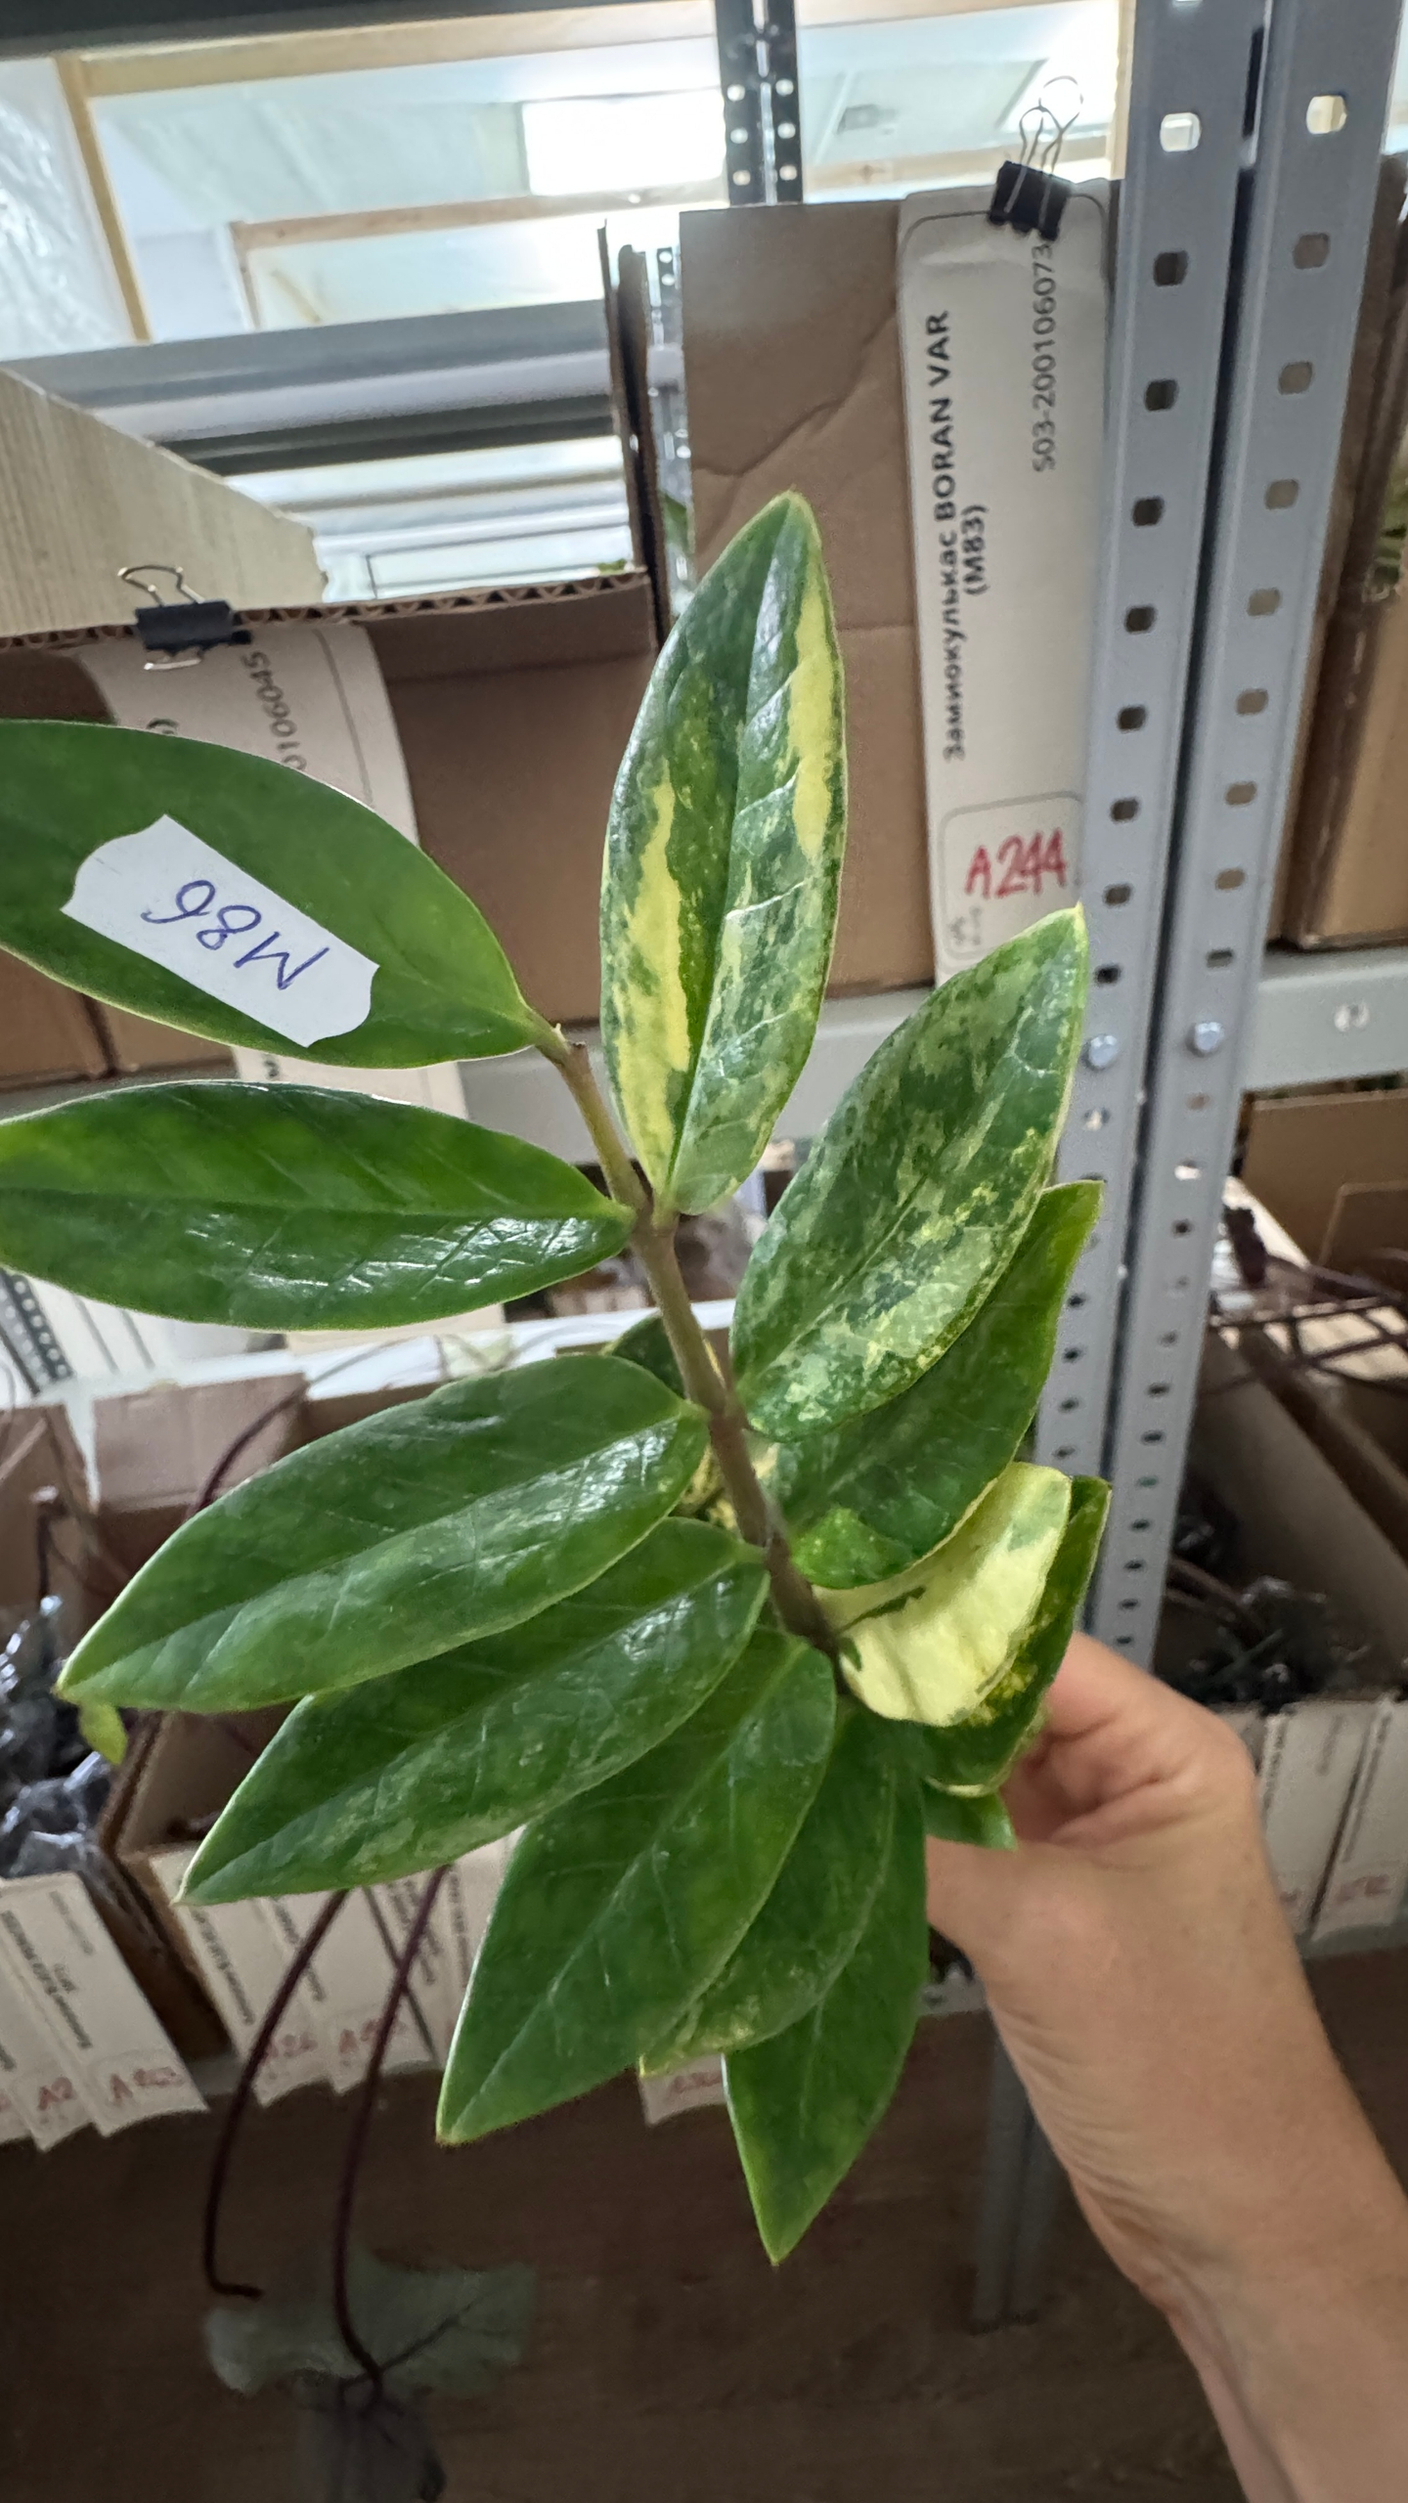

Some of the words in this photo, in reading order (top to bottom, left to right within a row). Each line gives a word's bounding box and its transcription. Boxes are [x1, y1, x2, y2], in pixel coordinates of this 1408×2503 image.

[925, 310, 951, 387] VAR
[929, 397, 956, 521] BORAN
[941, 531, 967, 761] Замиокулькас
[964, 828, 1066, 899] A244
[140, 879, 330, 990] M86
